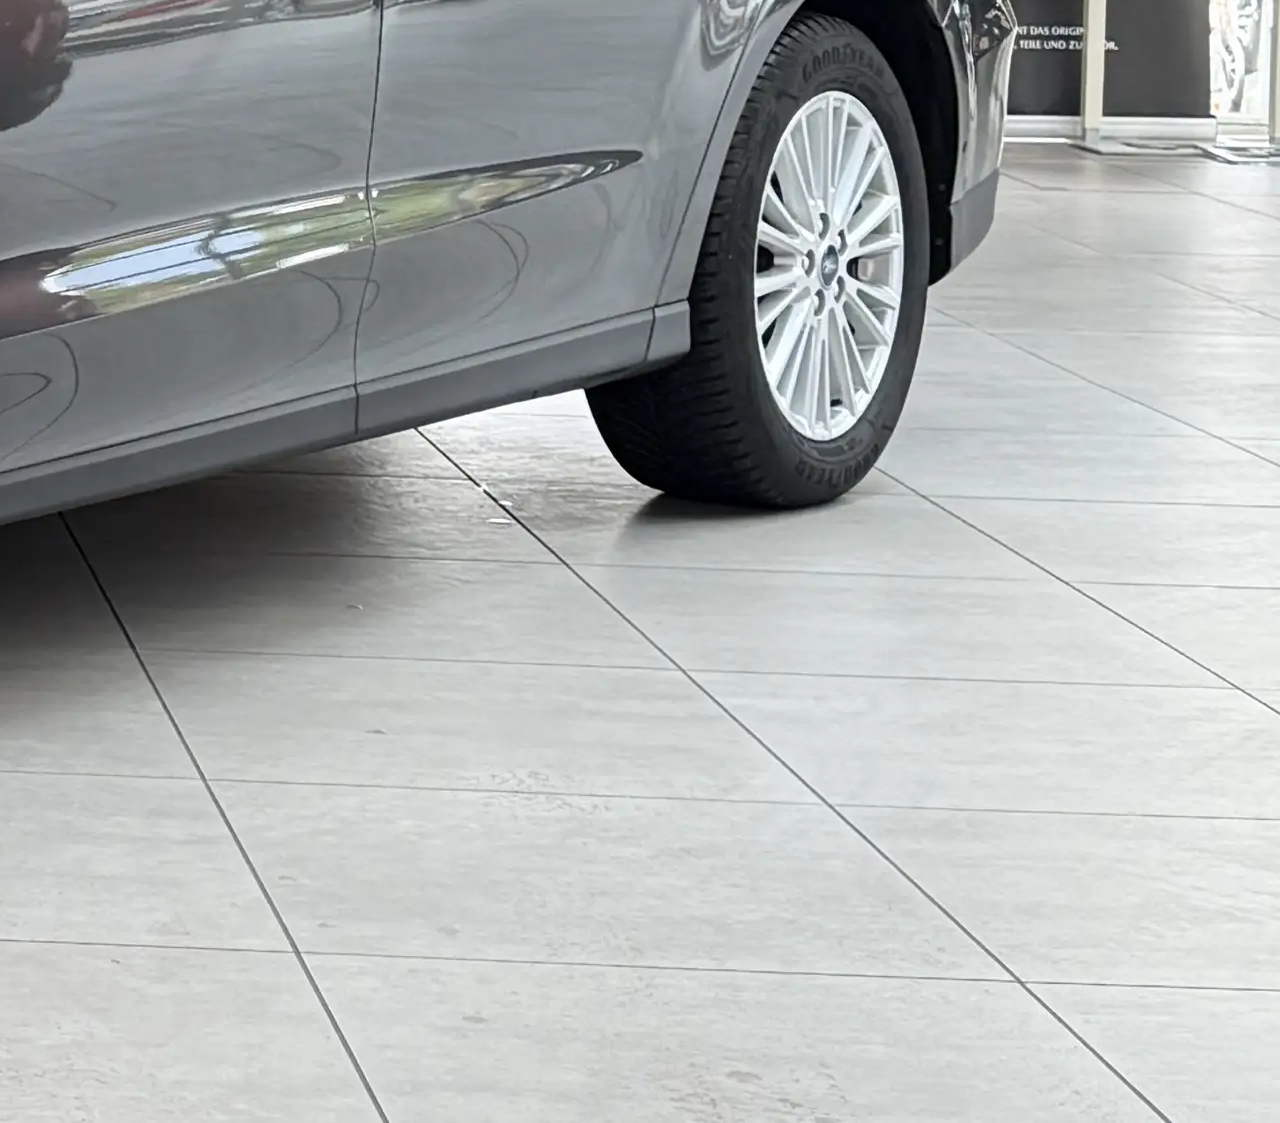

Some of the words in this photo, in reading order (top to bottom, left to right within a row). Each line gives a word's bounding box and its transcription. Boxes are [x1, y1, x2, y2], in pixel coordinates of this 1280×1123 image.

[1030, 27, 1050, 36] DAS
[1051, 27, 1085, 36] ORIGIN
[1020, 40, 1042, 50] TEILE
[1044, 40, 1066, 50] UND
